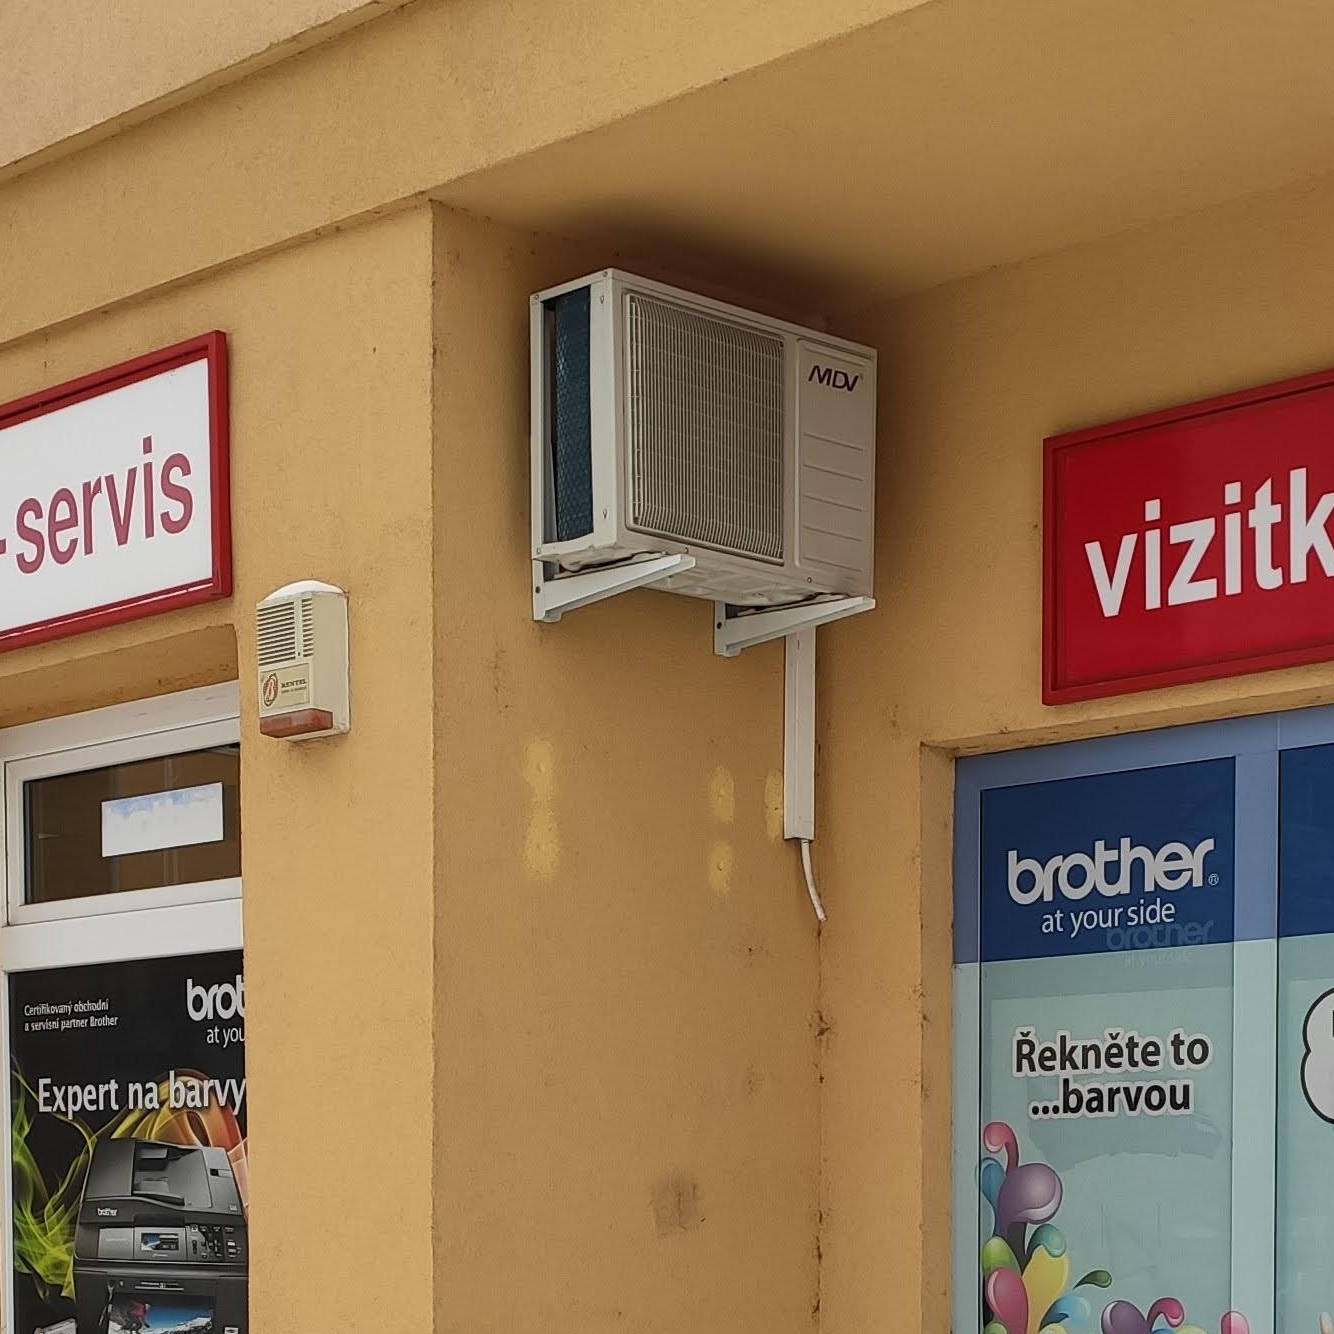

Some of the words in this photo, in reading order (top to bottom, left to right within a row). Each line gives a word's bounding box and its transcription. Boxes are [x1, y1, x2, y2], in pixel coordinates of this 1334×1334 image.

[808, 365, 859, 391] MDV
[1007, 837, 1215, 905] brother
[1041, 909, 1064, 934] at
[1070, 907, 1124, 939] your
[1127, 897, 1175, 926] side
[24, 999, 72, 1016] Certifikovaný
[74, 997, 109, 1013] obchodní
[24, 1021, 30, 1032] a
[61, 1017, 88, 1031] partner
[90, 1014, 118, 1027] Brother
[206, 1028, 219, 1044] at
[1016, 1030, 1161, 1073] Řekněte
[1170, 1032, 1209, 1066] to
[38, 1077, 119, 1120] Expert
[128, 1080, 160, 1110] na
[169, 1070, 246, 1116] barvy
[1031, 1077, 1191, 1116] ...barvou
